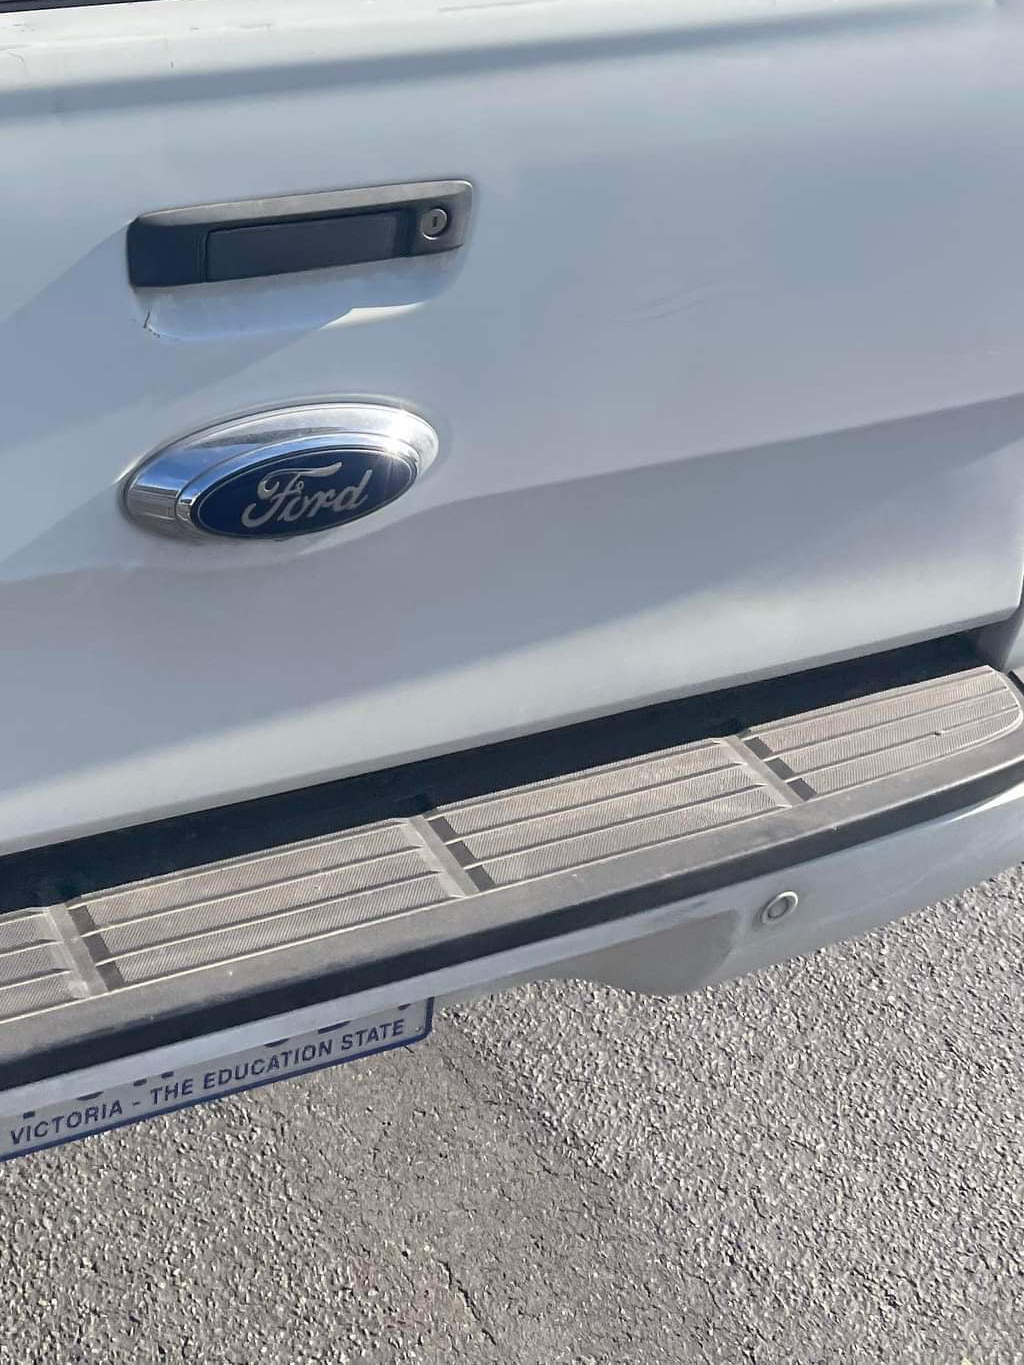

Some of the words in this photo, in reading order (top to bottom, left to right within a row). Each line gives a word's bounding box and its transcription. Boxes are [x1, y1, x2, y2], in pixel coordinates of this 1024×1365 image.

[241, 462, 373, 528] Ford
[10, 1099, 123, 1146] VICTORIA
[150, 1078, 194, 1106] THE
[203, 1038, 333, 1089] EDUCATION
[341, 1018, 405, 1052] STATE
